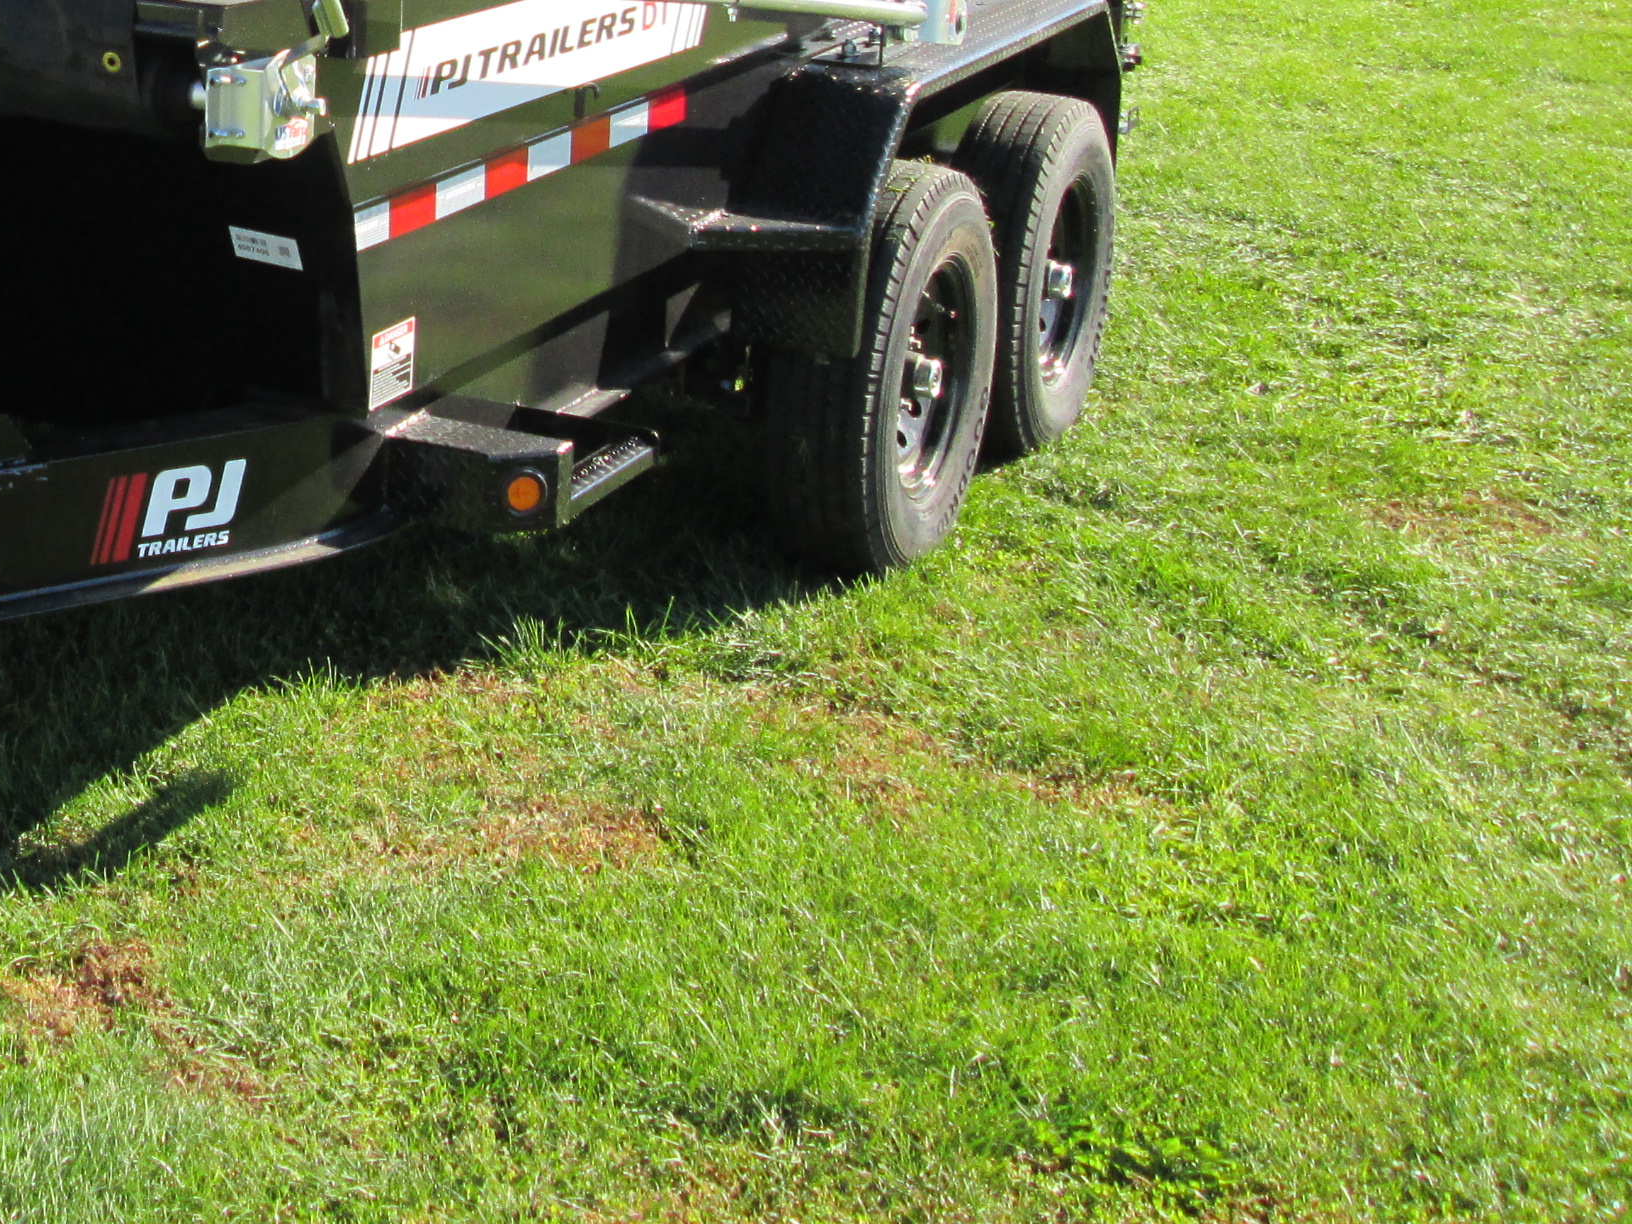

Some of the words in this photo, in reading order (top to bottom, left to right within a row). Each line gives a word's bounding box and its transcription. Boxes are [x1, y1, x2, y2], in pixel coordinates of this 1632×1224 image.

[430, 54, 472, 96] PJ
[478, 6, 637, 80] TRAILERS
[141, 459, 247, 538] PJ
[137, 530, 230, 558] TRAILERS
